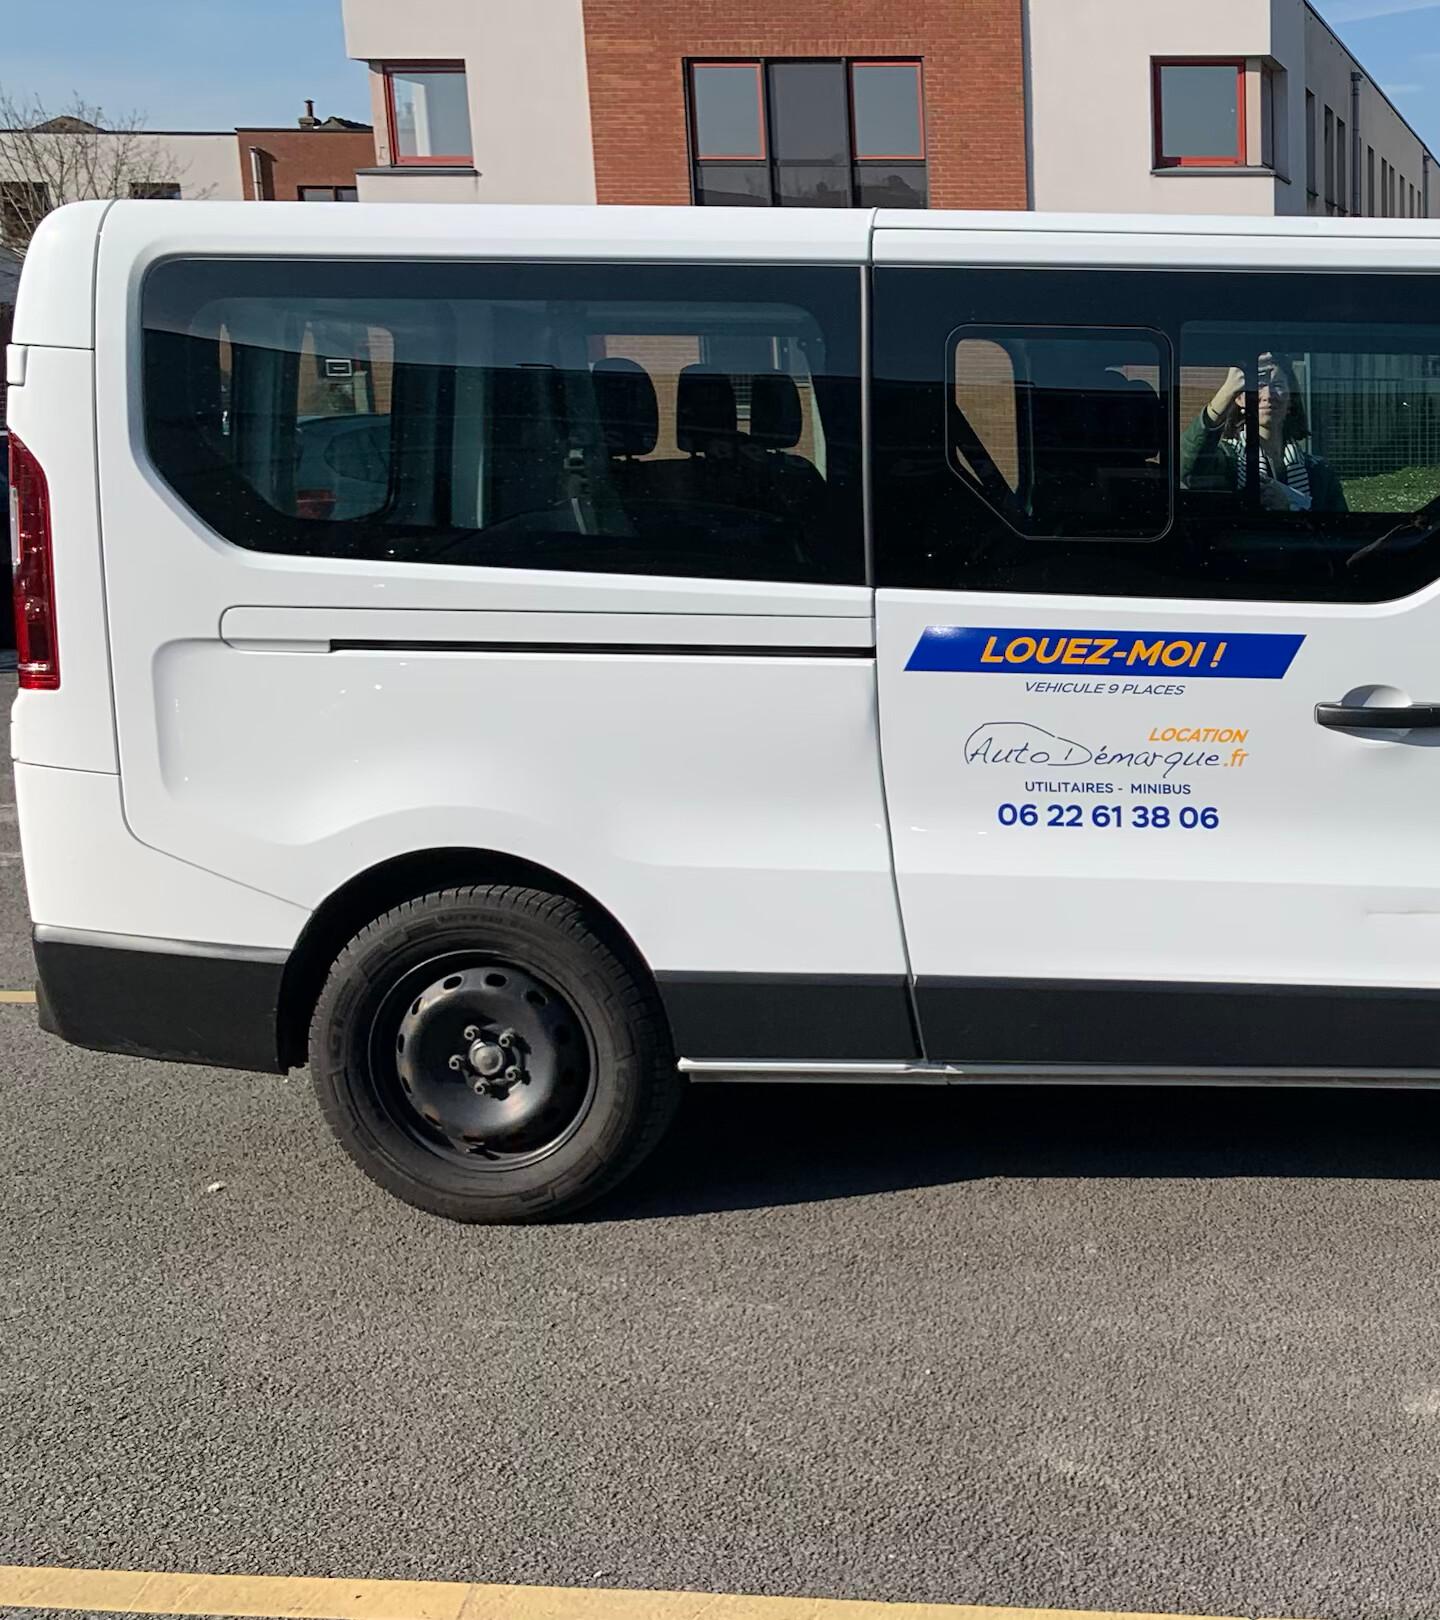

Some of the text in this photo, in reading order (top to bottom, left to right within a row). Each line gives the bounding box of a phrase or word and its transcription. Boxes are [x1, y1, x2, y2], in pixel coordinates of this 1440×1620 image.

[980, 635, 1227, 668] LOUEZ-MOI !
[1025, 681, 1186, 695] VEHICULE 9 PLACES
[1148, 727, 1249, 743] LOCATION
[1025, 781, 1114, 794] UTILITAIRES
[1130, 783, 1191, 795] MINIBUS
[997, 803, 1220, 830] 06 22 61 38 06
